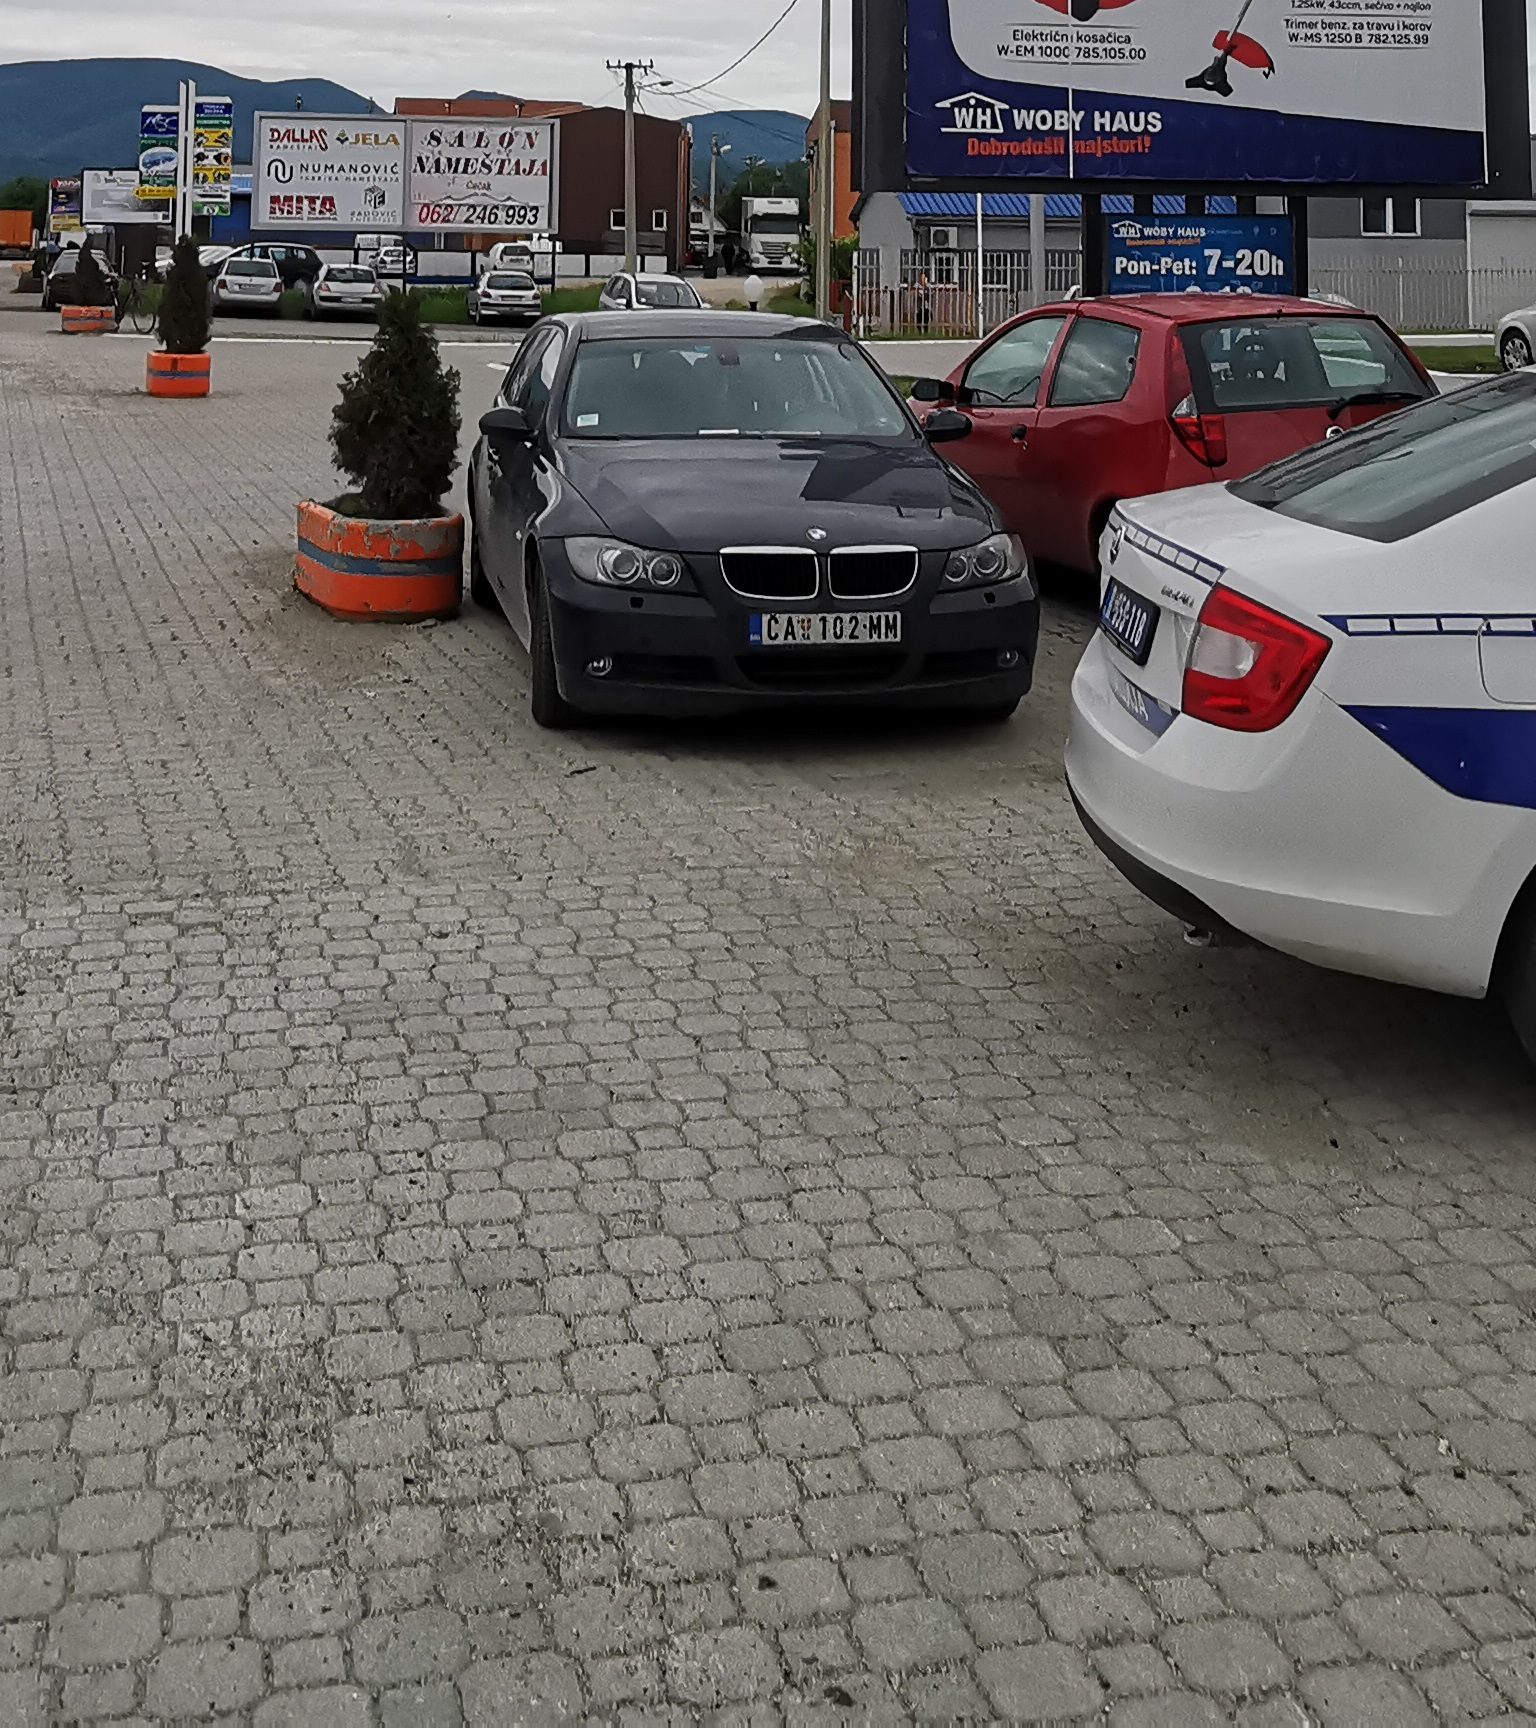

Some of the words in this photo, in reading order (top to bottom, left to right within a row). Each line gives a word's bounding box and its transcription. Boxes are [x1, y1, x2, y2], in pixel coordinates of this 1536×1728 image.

[1403, 1, 1431, 13] najlon
[1284, 18, 1319, 30] Trimer
[1352, 21, 1364, 30] za
[1366, 20, 1395, 31] travu
[1402, 21, 1432, 32] korov
[1013, 28, 1073, 43] Električn
[1077, 30, 1132, 44] kosačica
[1288, 32, 1322, 43] W-MS
[1326, 33, 1352, 43] 1250
[1354, 33, 1363, 44] B
[997, 44, 1035, 57] W-EM
[1074, 46, 1146, 60] 785.105.00
[953, 107, 992, 129] WH
[1013, 108, 1085, 131] WOBY
[1093, 110, 1163, 133] HAUS
[269, 127, 329, 152] DALLAS
[349, 133, 400, 146] JELA
[300, 162, 399, 175] NUMANOVIĆ
[412, 152, 548, 177] NAMEŠTAJA
[269, 194, 338, 216] MITA
[465, 204, 499, 224] 246
[505, 204, 539, 225] 993
[1143, 226, 1174, 237] WOBY
[1178, 226, 1207, 237] HAUS
[1115, 256, 1197, 275] Pon-Pet:
[1204, 248, 1284, 276] 7-20h
